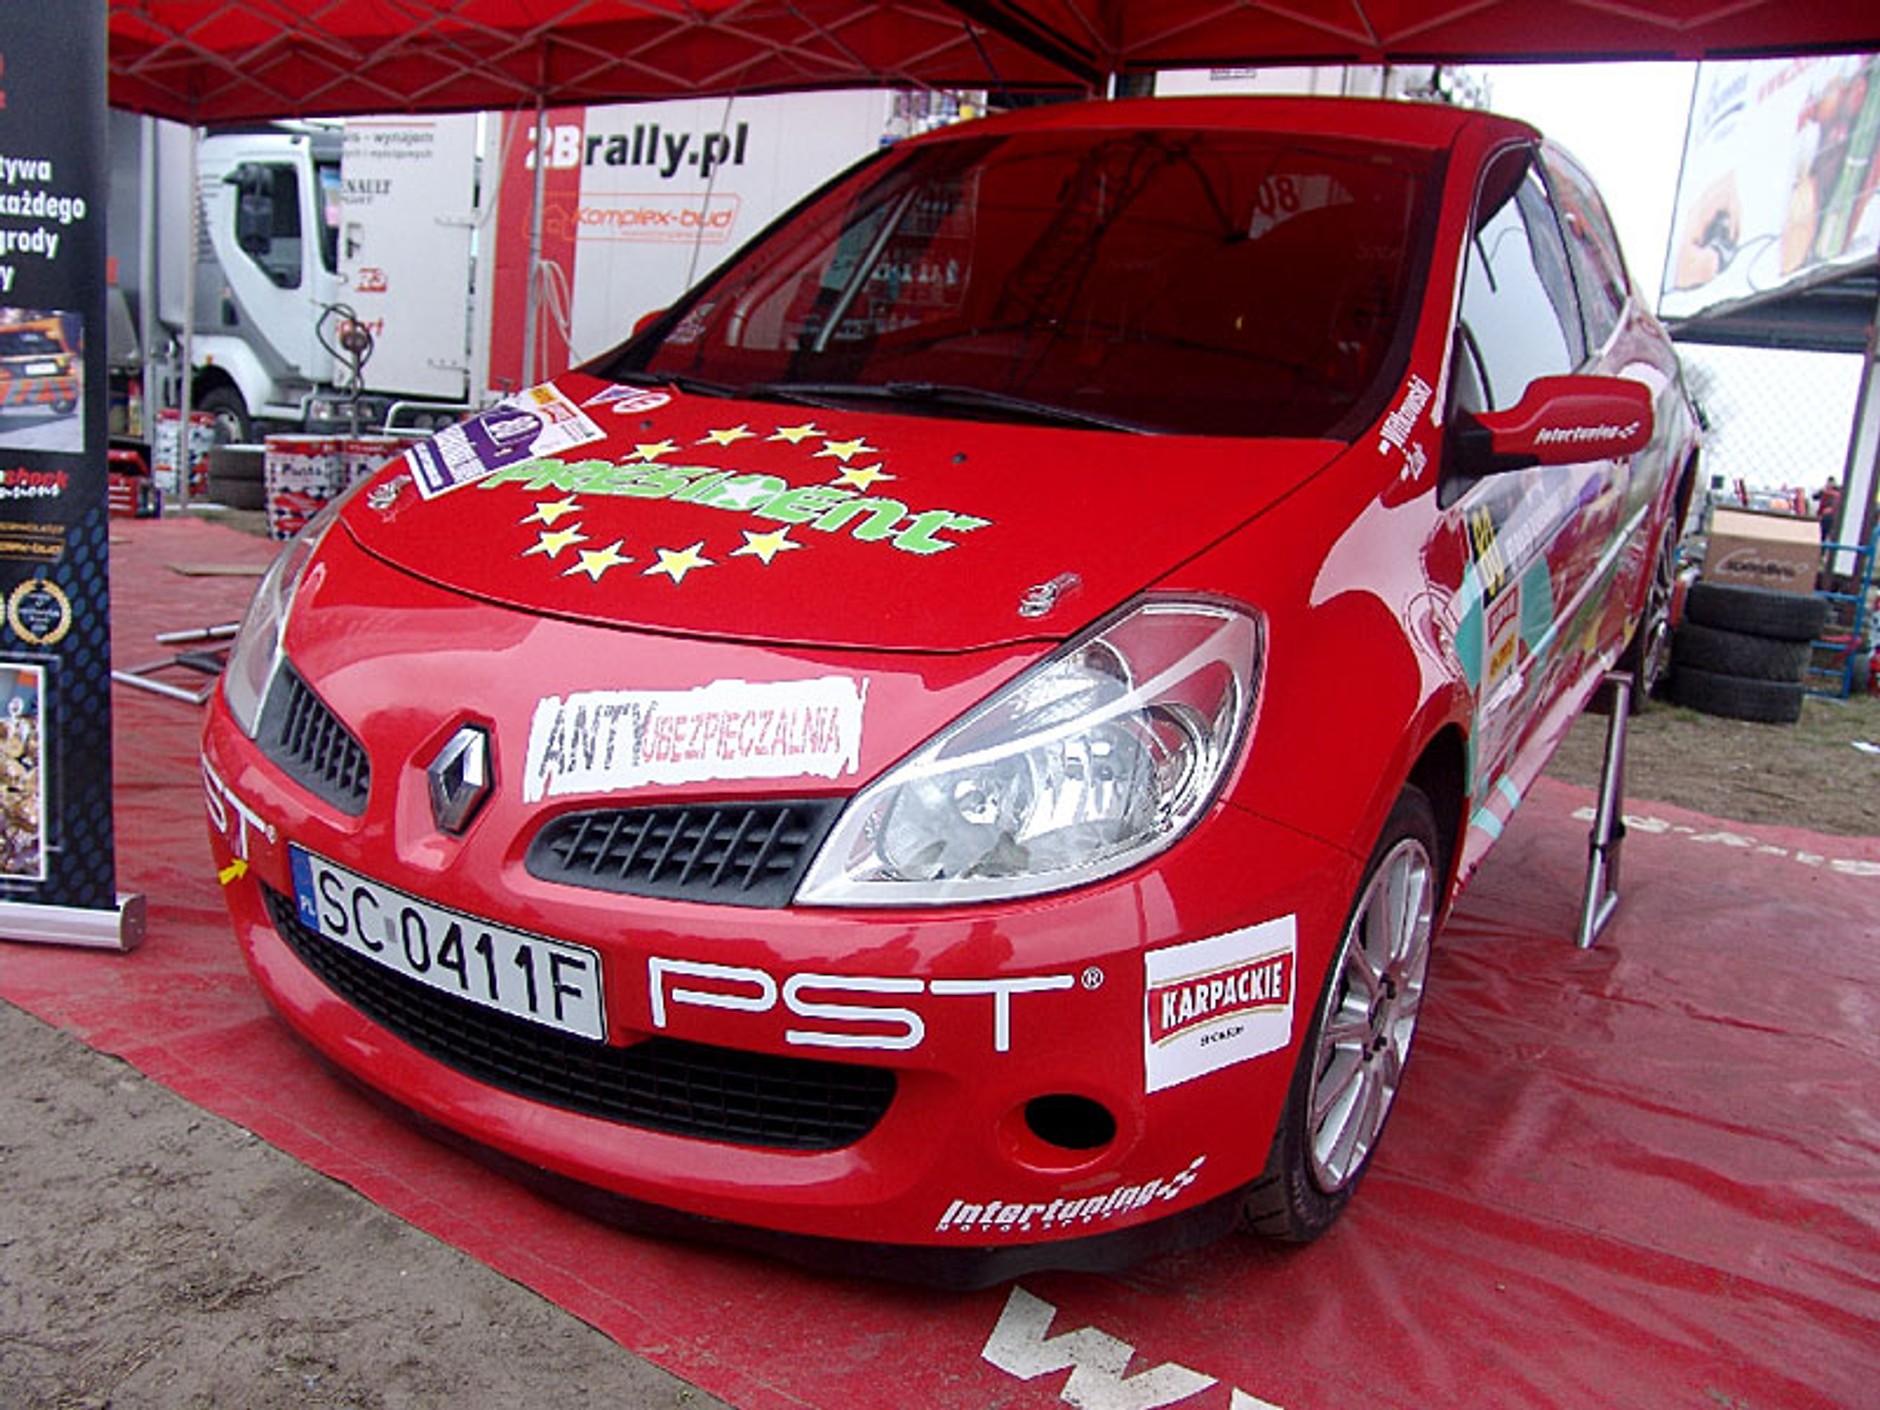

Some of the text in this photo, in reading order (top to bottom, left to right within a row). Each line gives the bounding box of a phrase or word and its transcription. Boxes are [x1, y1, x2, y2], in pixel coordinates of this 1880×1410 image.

[318, 870, 384, 952] SC
[400, 906, 586, 1021] 0411F
[1161, 961, 1283, 1031] KARPACKIE
[939, 1178, 1163, 1224] Intertuning
